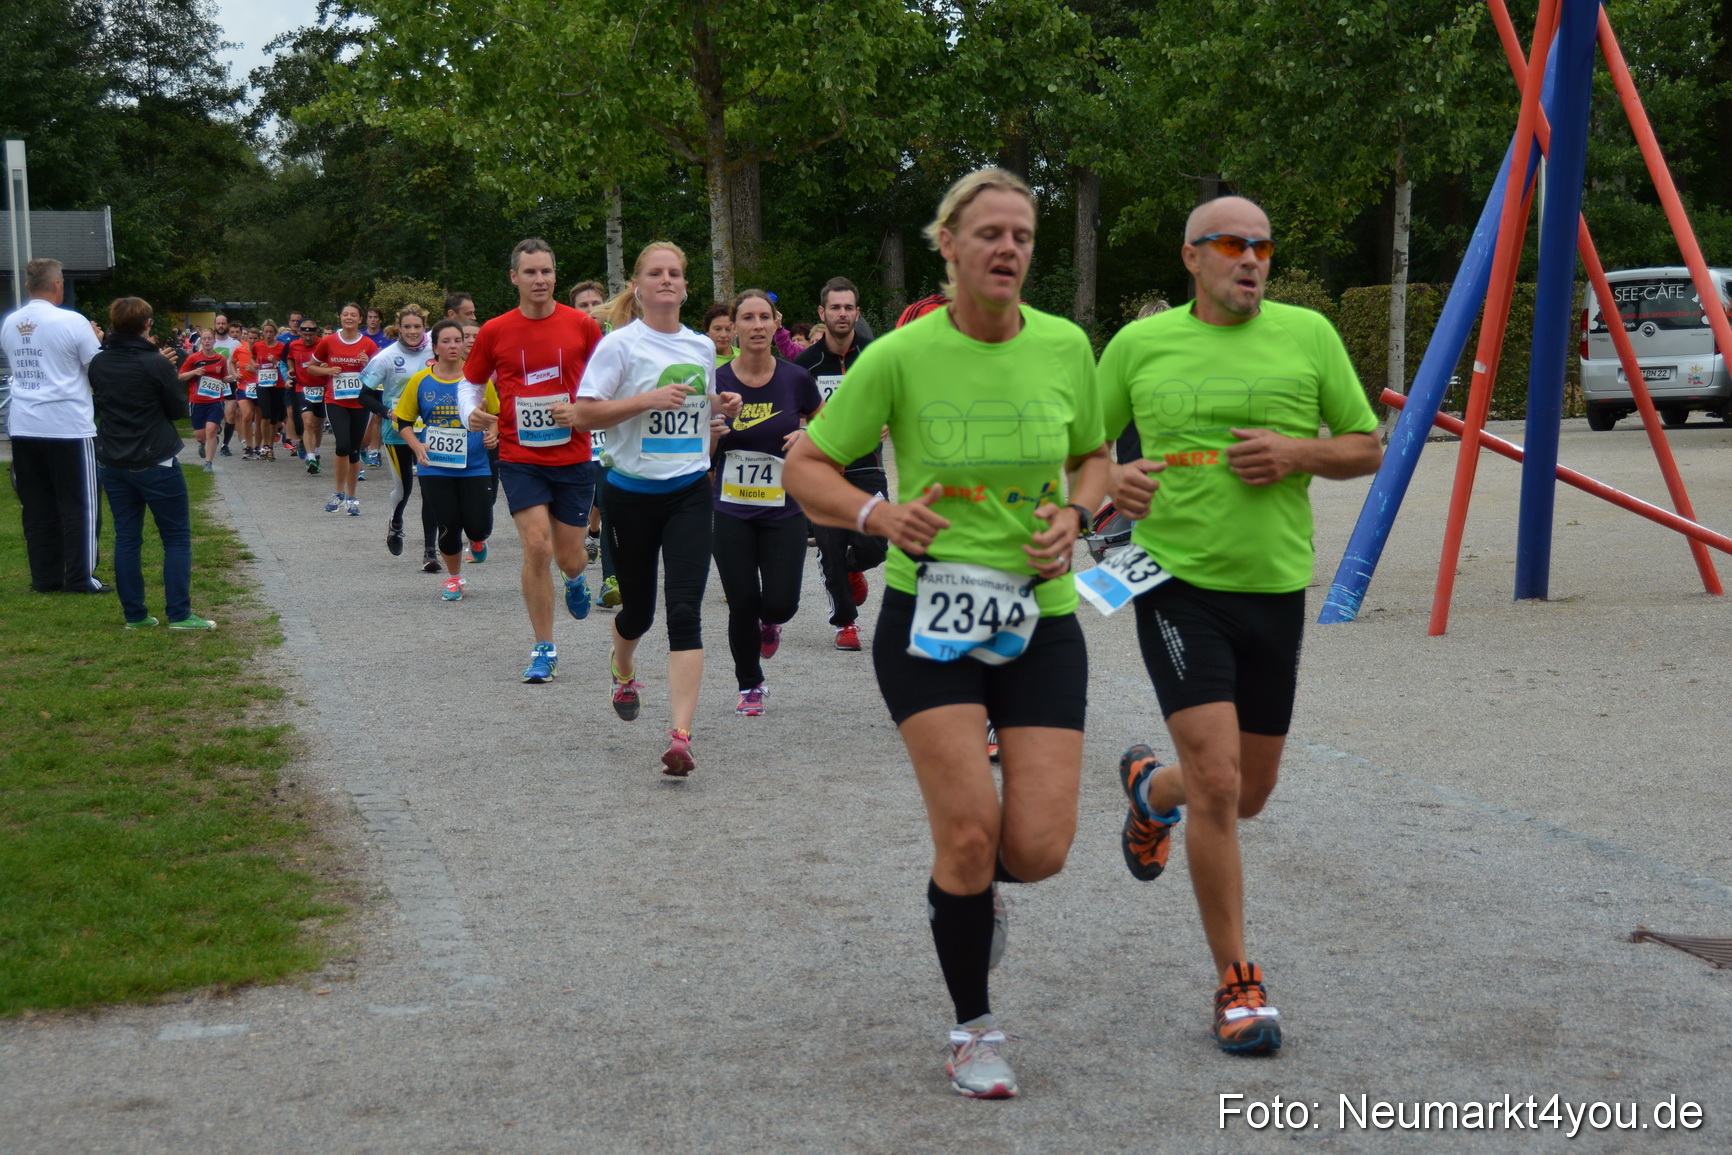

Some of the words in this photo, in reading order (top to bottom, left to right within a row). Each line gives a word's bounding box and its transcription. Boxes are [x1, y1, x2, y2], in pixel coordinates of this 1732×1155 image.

[22, 336, 31, 345] IM
[16, 359, 40, 368] SEINER
[21, 382, 40, 391] JESUS
[201, 381, 220, 392] 2426
[335, 378, 360, 390] 2160
[740, 402, 774, 419] RUN
[648, 411, 700, 435] 3021
[429, 436, 464, 453] 2632
[431, 454, 457, 463] Jennifer
[1164, 450, 1220, 467] MERZ
[735, 463, 774, 485] 174
[739, 489, 766, 499] Nicole
[921, 573, 959, 586] PARTL
[961, 575, 1016, 593] Neumarkt
[928, 592, 1026, 634] 2344
